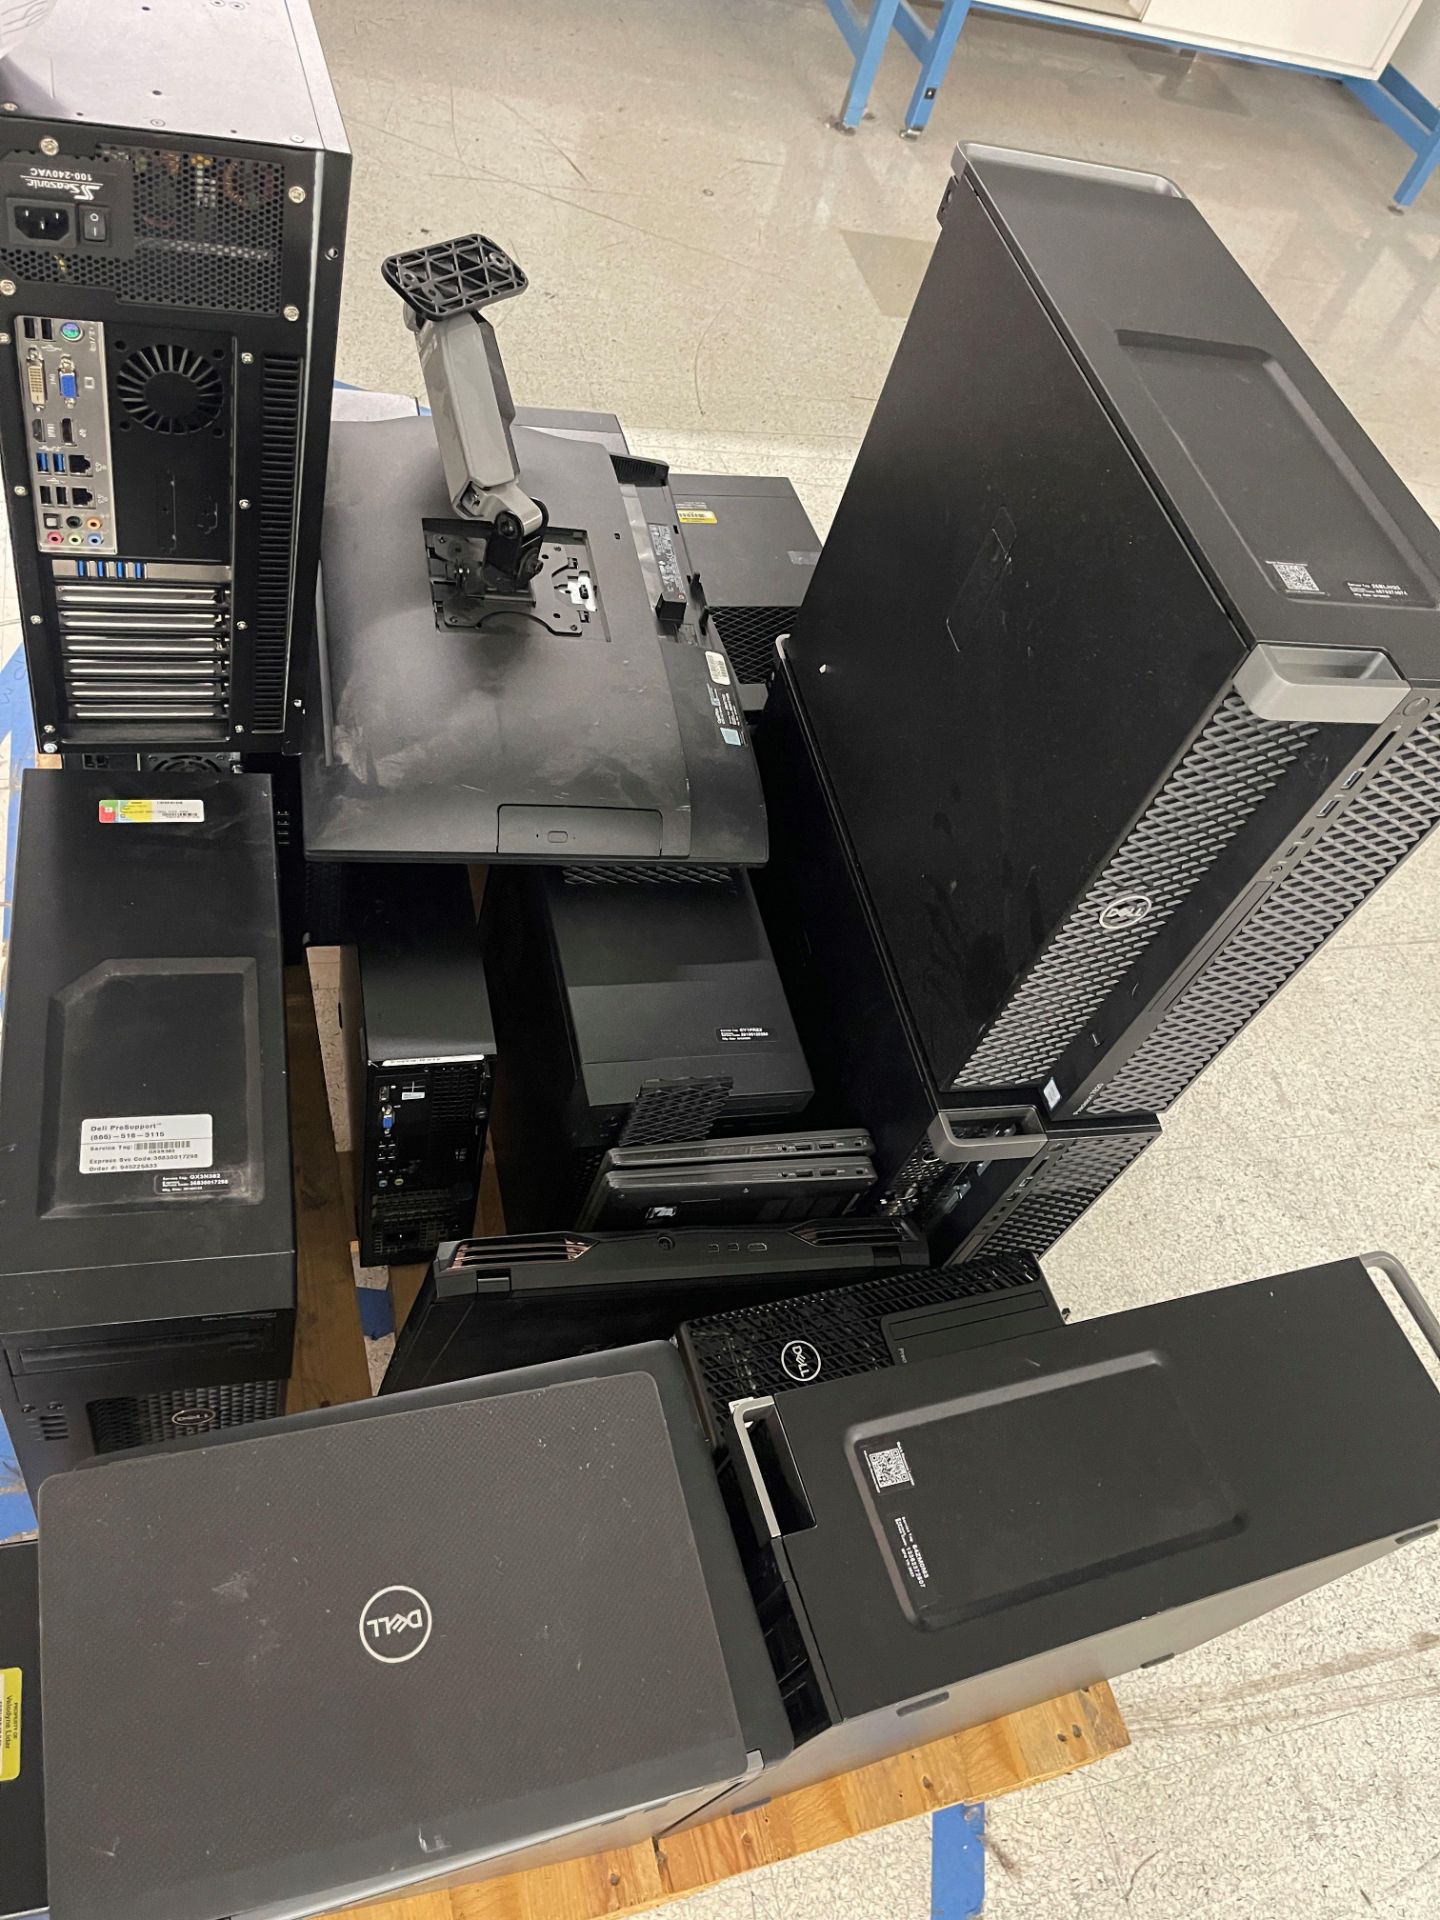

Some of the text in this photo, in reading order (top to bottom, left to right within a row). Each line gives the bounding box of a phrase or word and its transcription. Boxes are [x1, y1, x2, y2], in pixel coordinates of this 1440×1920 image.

[30, 167, 92, 181] 100-240VAC
[24, 178, 80, 194] Seasonic
[1106, 906, 1144, 919] DELL
[792, 1345, 809, 1378] DELL
[366, 1609, 423, 1638] DELL
